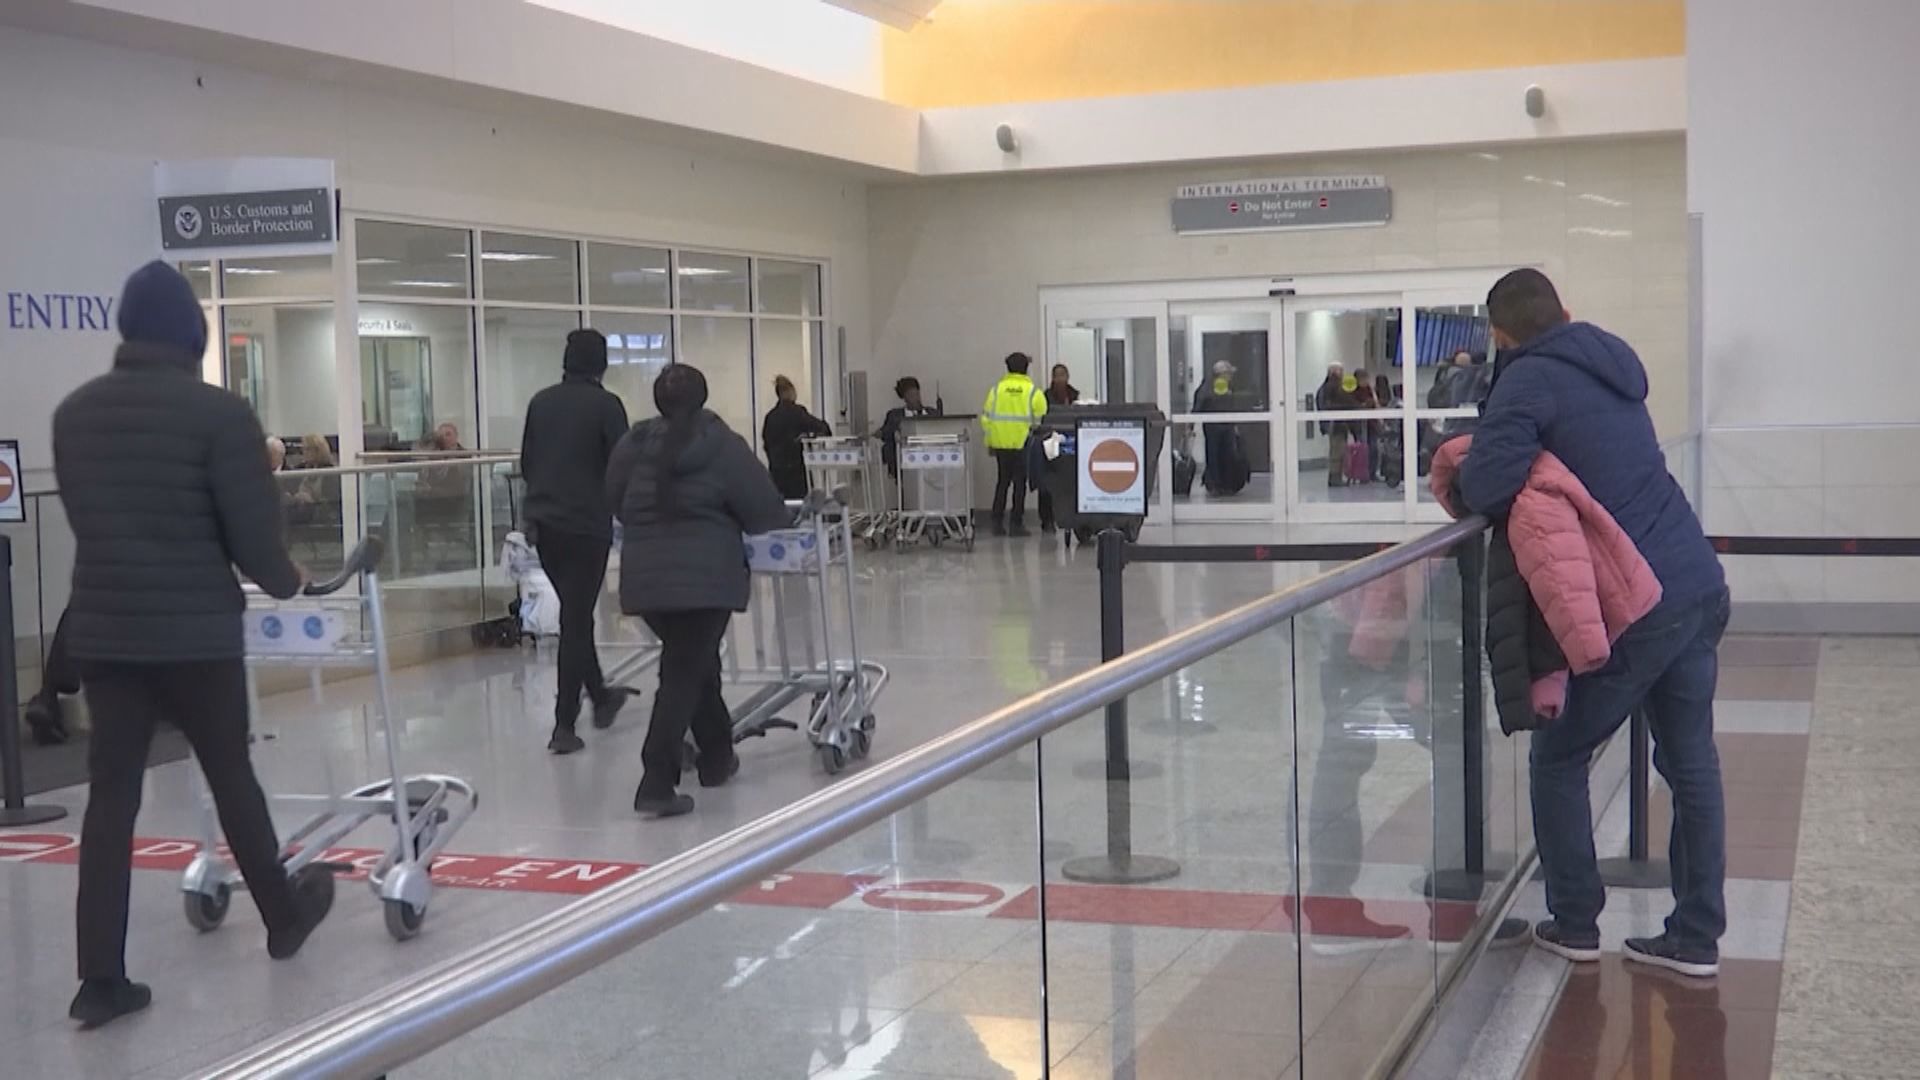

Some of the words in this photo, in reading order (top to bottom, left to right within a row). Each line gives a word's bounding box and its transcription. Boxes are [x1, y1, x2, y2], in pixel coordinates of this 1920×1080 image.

[1181, 182, 1297, 197] INTERNATIONAL
[1303, 176, 1379, 190] TERMINAL
[209, 205, 235, 219] U.S.
[237, 203, 289, 218] Customs
[291, 200, 313, 215] and
[1244, 201, 1260, 212] Do
[1262, 200, 1281, 211] Not
[1284, 199, 1313, 209] Enter
[211, 221, 251, 236] Border
[253, 217, 314, 234] Protection
[7, 292, 113, 330] ENTRY
